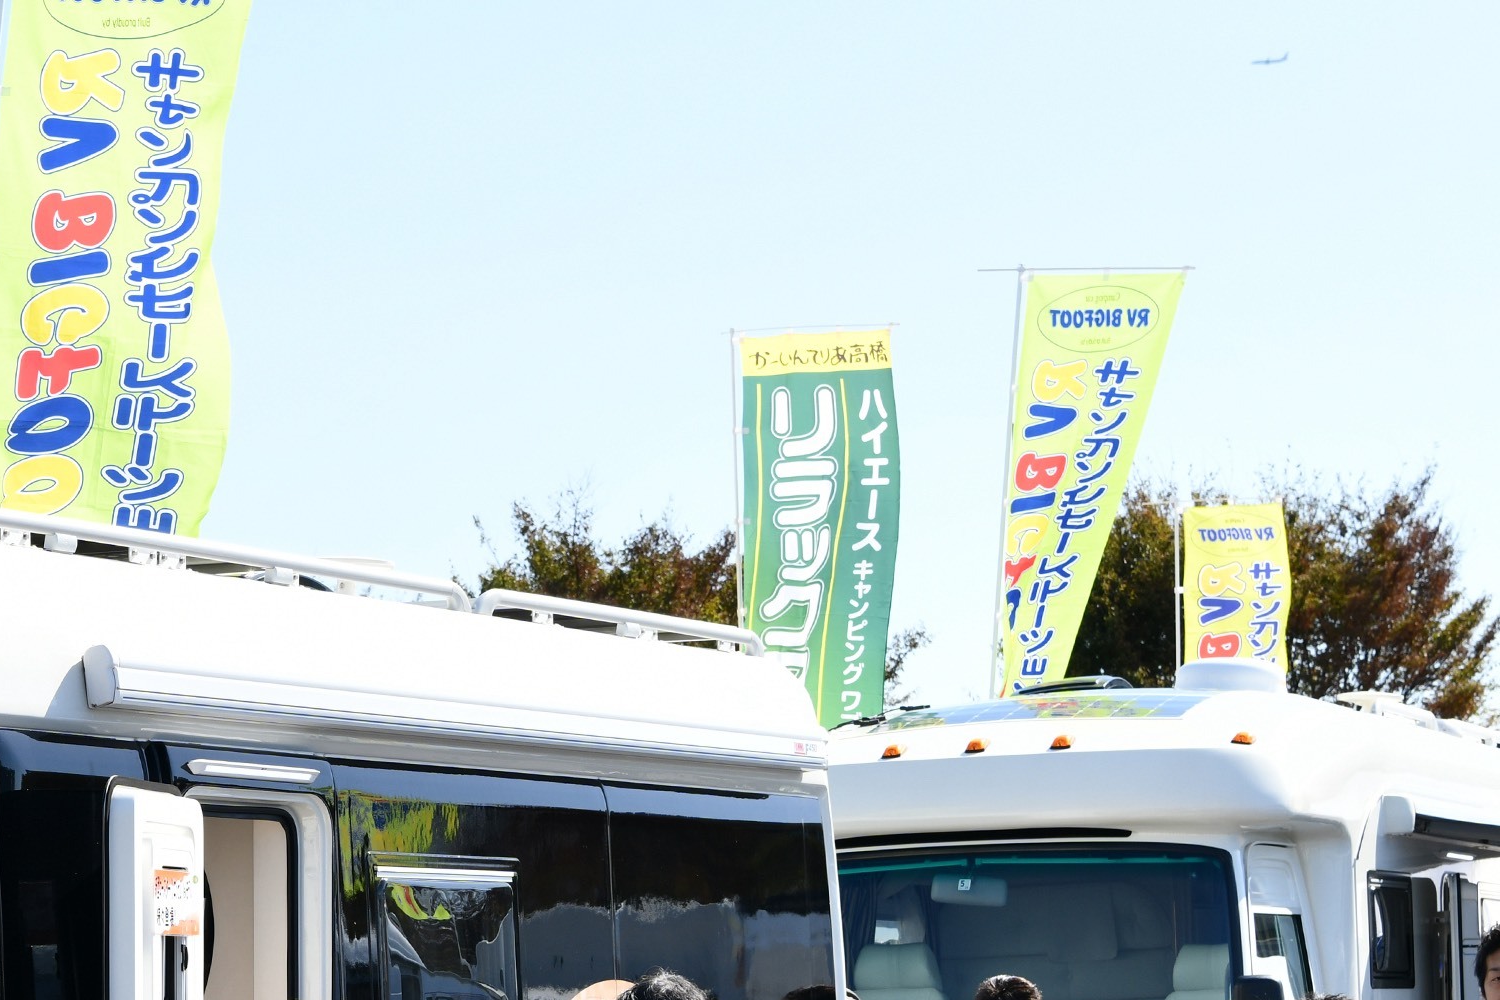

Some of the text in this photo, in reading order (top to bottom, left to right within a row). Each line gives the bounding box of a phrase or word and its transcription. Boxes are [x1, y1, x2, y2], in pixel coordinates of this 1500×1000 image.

[852, 389, 890, 552] ハイエース
[843, 559, 874, 686] キャンピング
